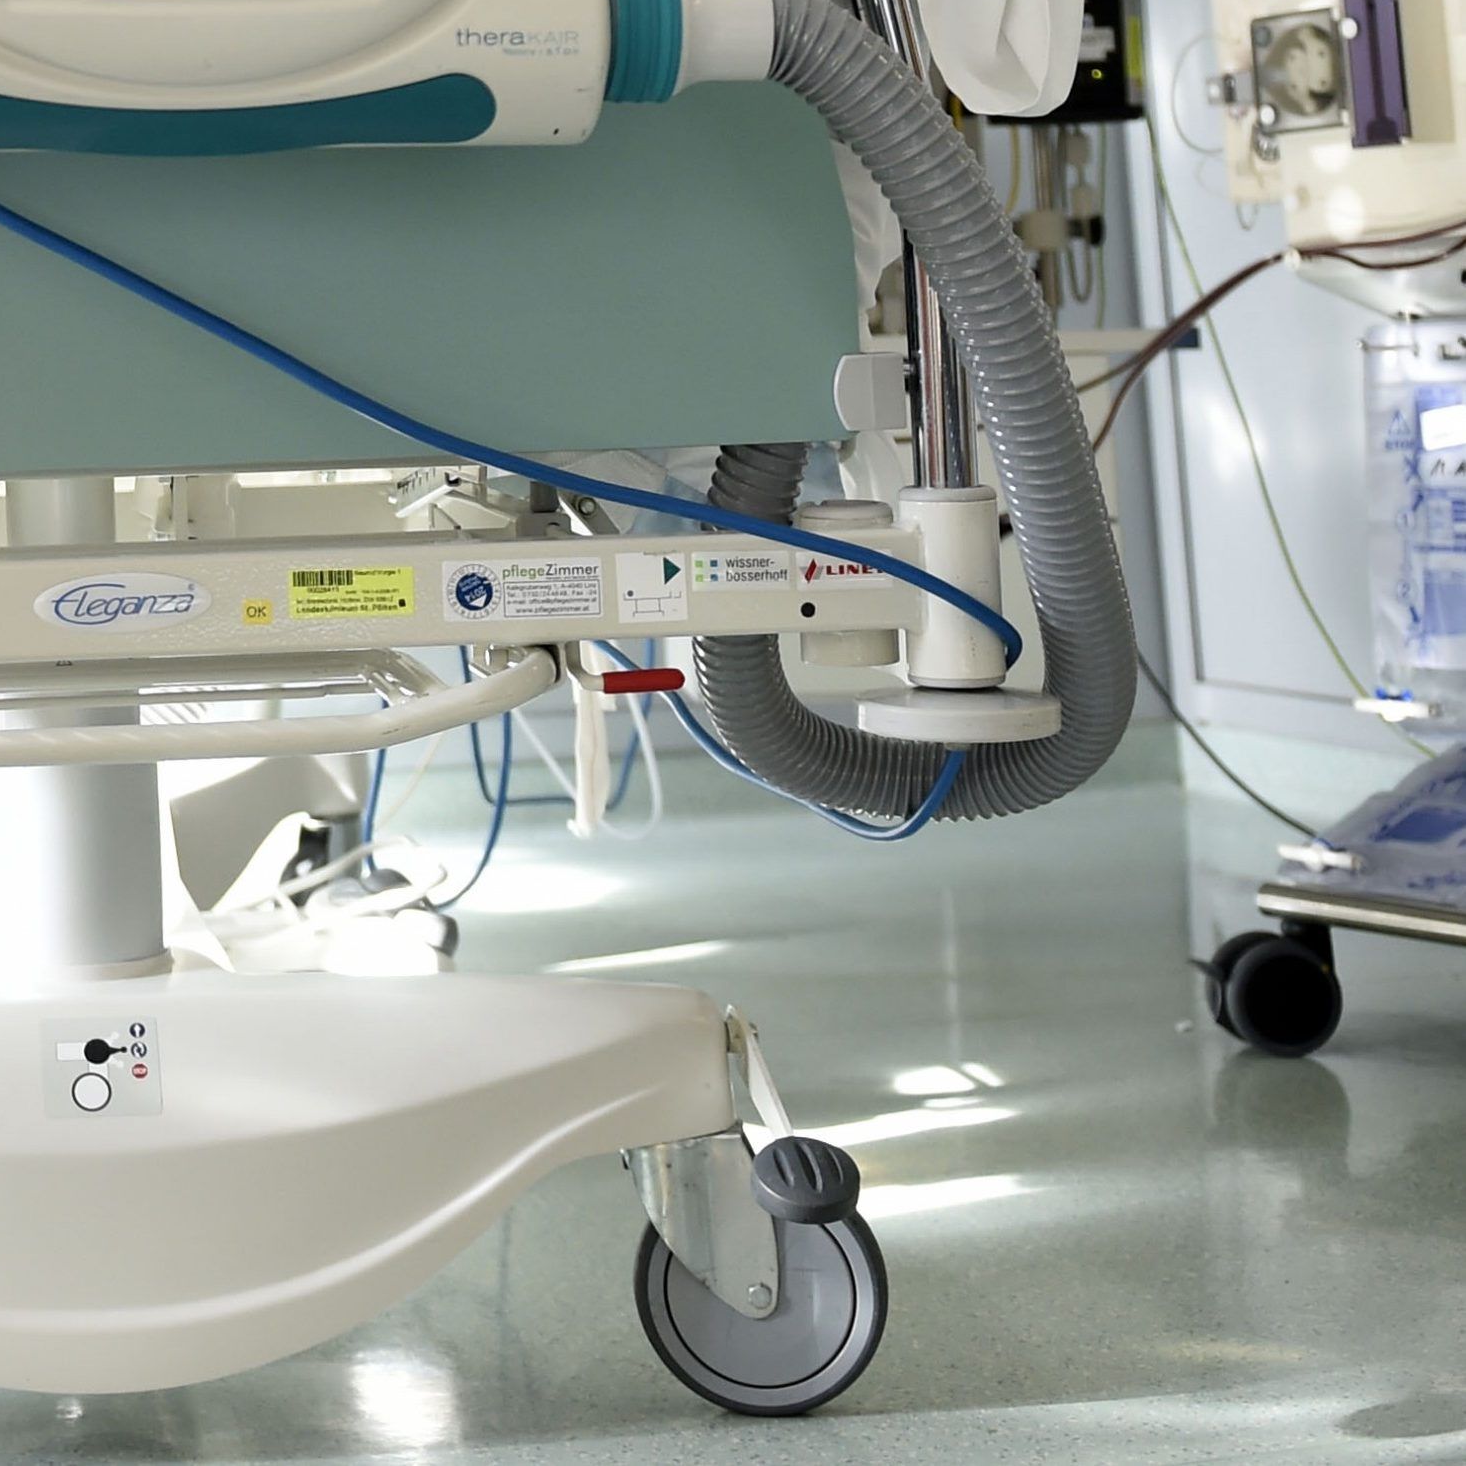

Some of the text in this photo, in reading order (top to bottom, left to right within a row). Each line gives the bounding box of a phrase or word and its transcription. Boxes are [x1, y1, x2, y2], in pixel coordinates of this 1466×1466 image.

[725, 556, 775, 568] wissner-
[502, 563, 599, 579] pflegeZimmer
[726, 569, 788, 582] bosserhoff
[246, 606, 267, 618] OK
